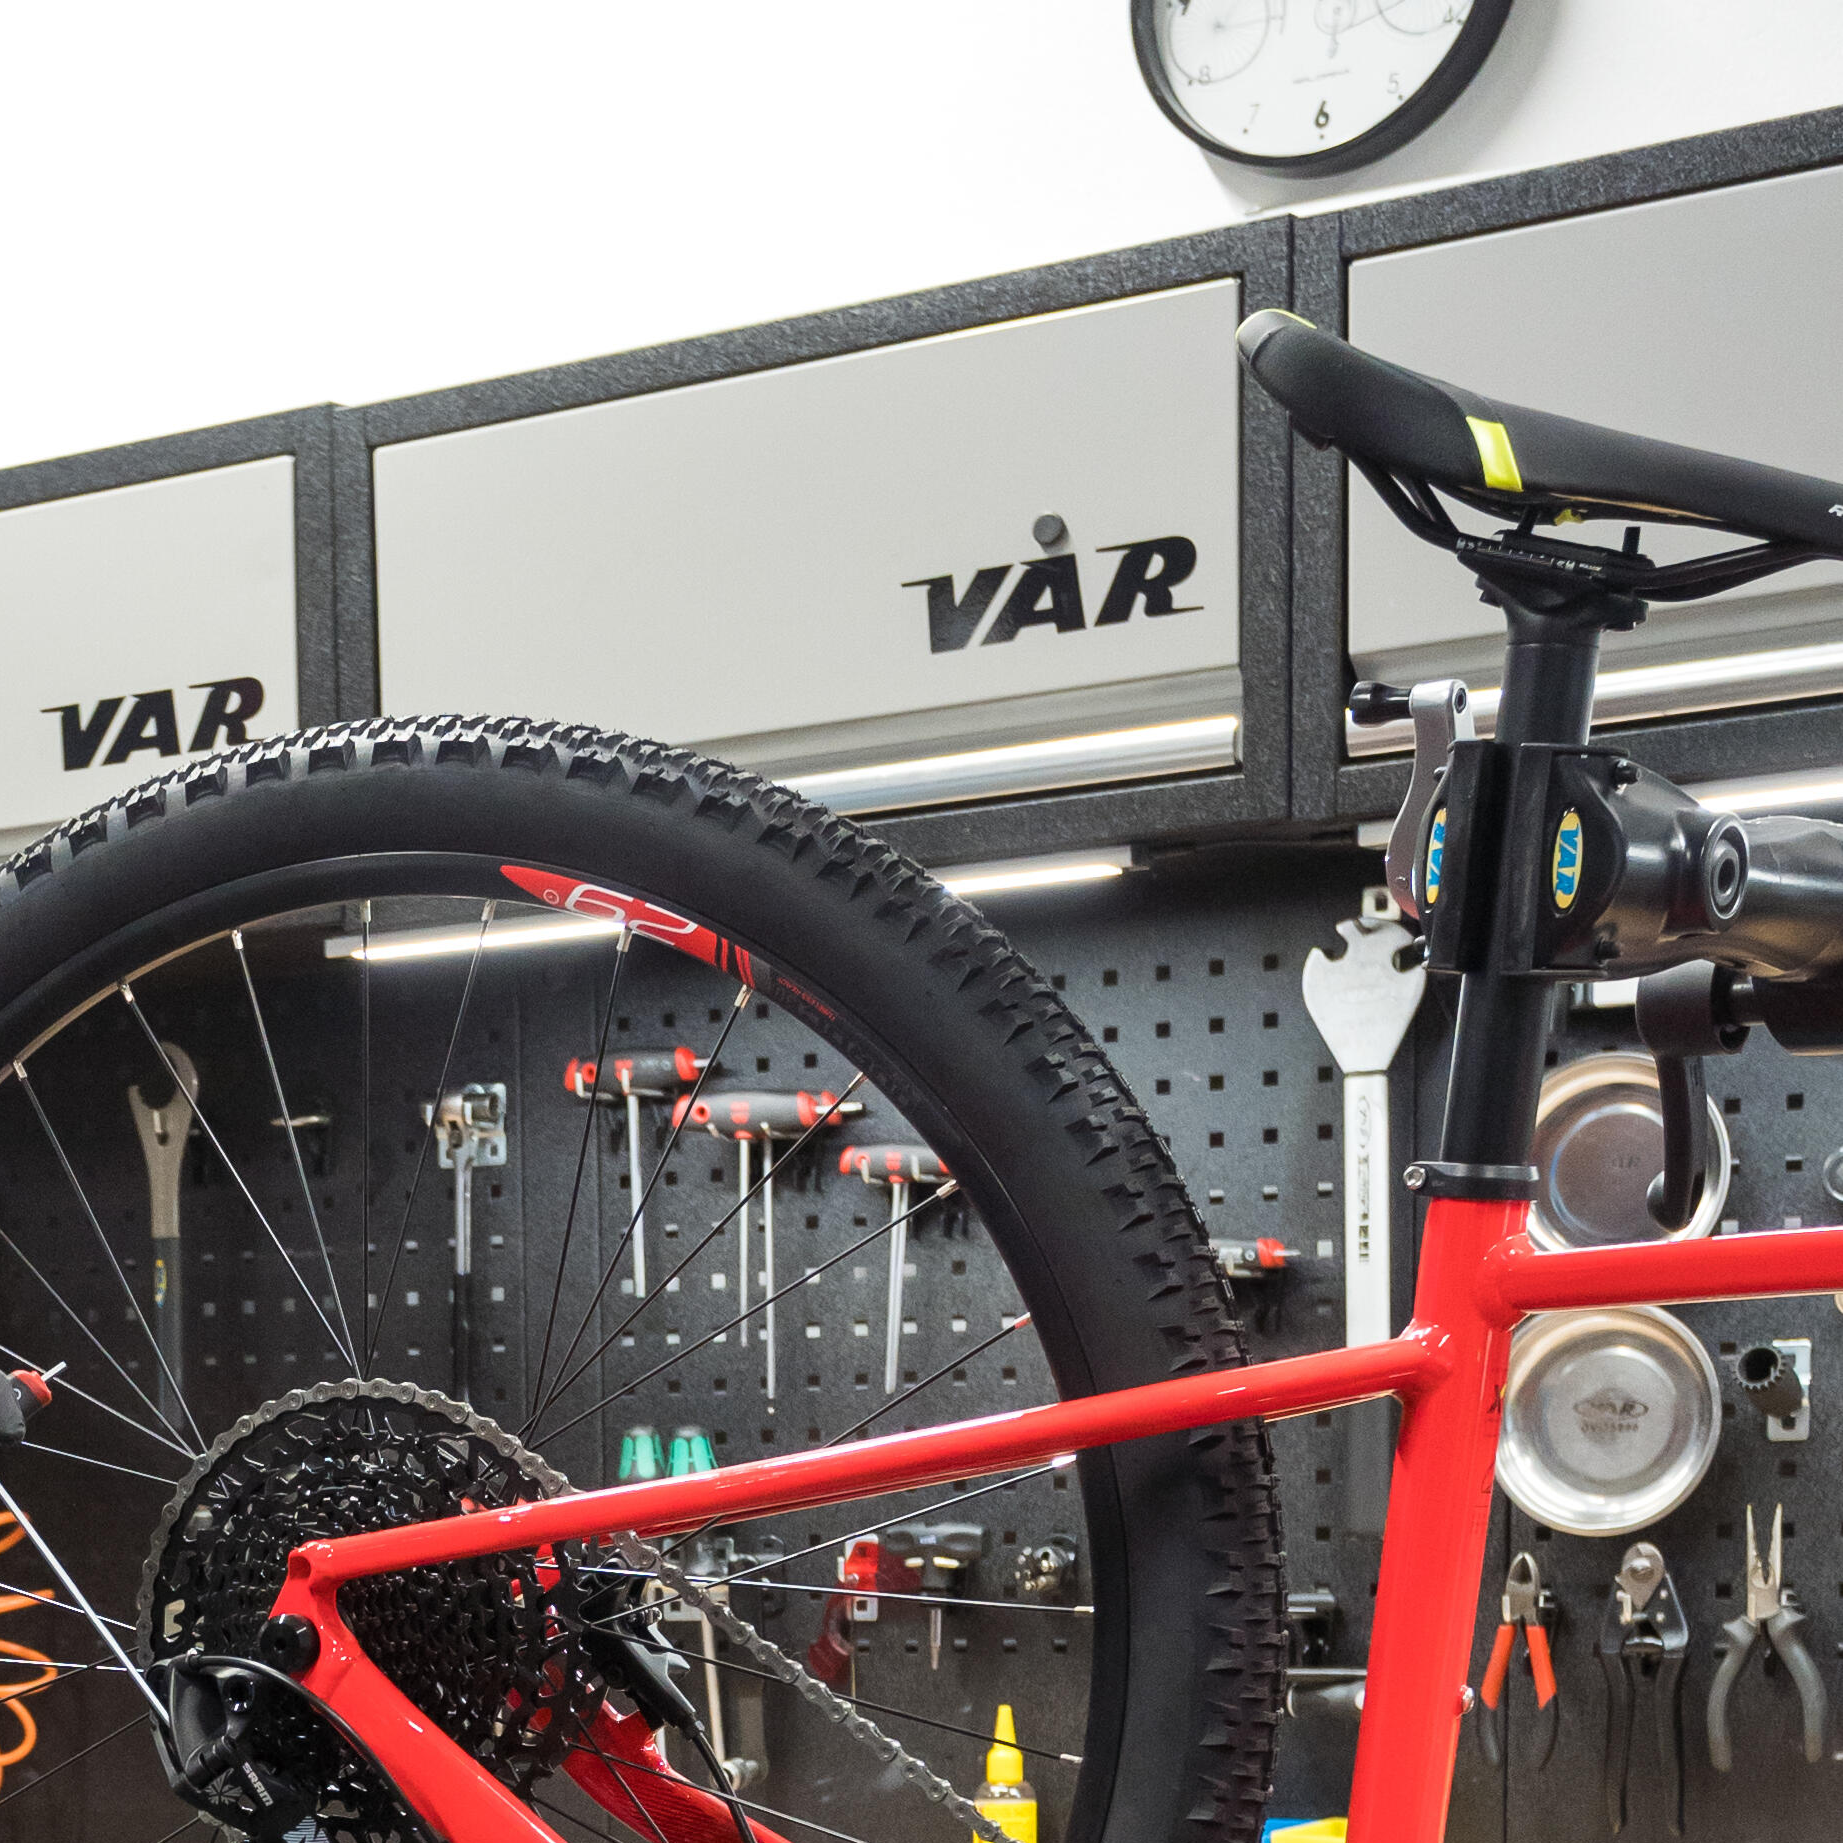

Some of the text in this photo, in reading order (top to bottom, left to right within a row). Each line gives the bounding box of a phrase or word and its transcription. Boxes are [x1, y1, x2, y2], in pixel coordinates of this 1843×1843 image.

[1198, 64, 1213, 86] 8
[1386, 72, 1400, 94] 5
[1314, 99, 1330, 129] 6
[902, 536, 1204, 653] VAR
[41, 677, 267, 772] VAR
[1555, 823, 1581, 896] VAR
[565, 884, 698, 946] 29
[242, 1761, 274, 1806] SRAM
